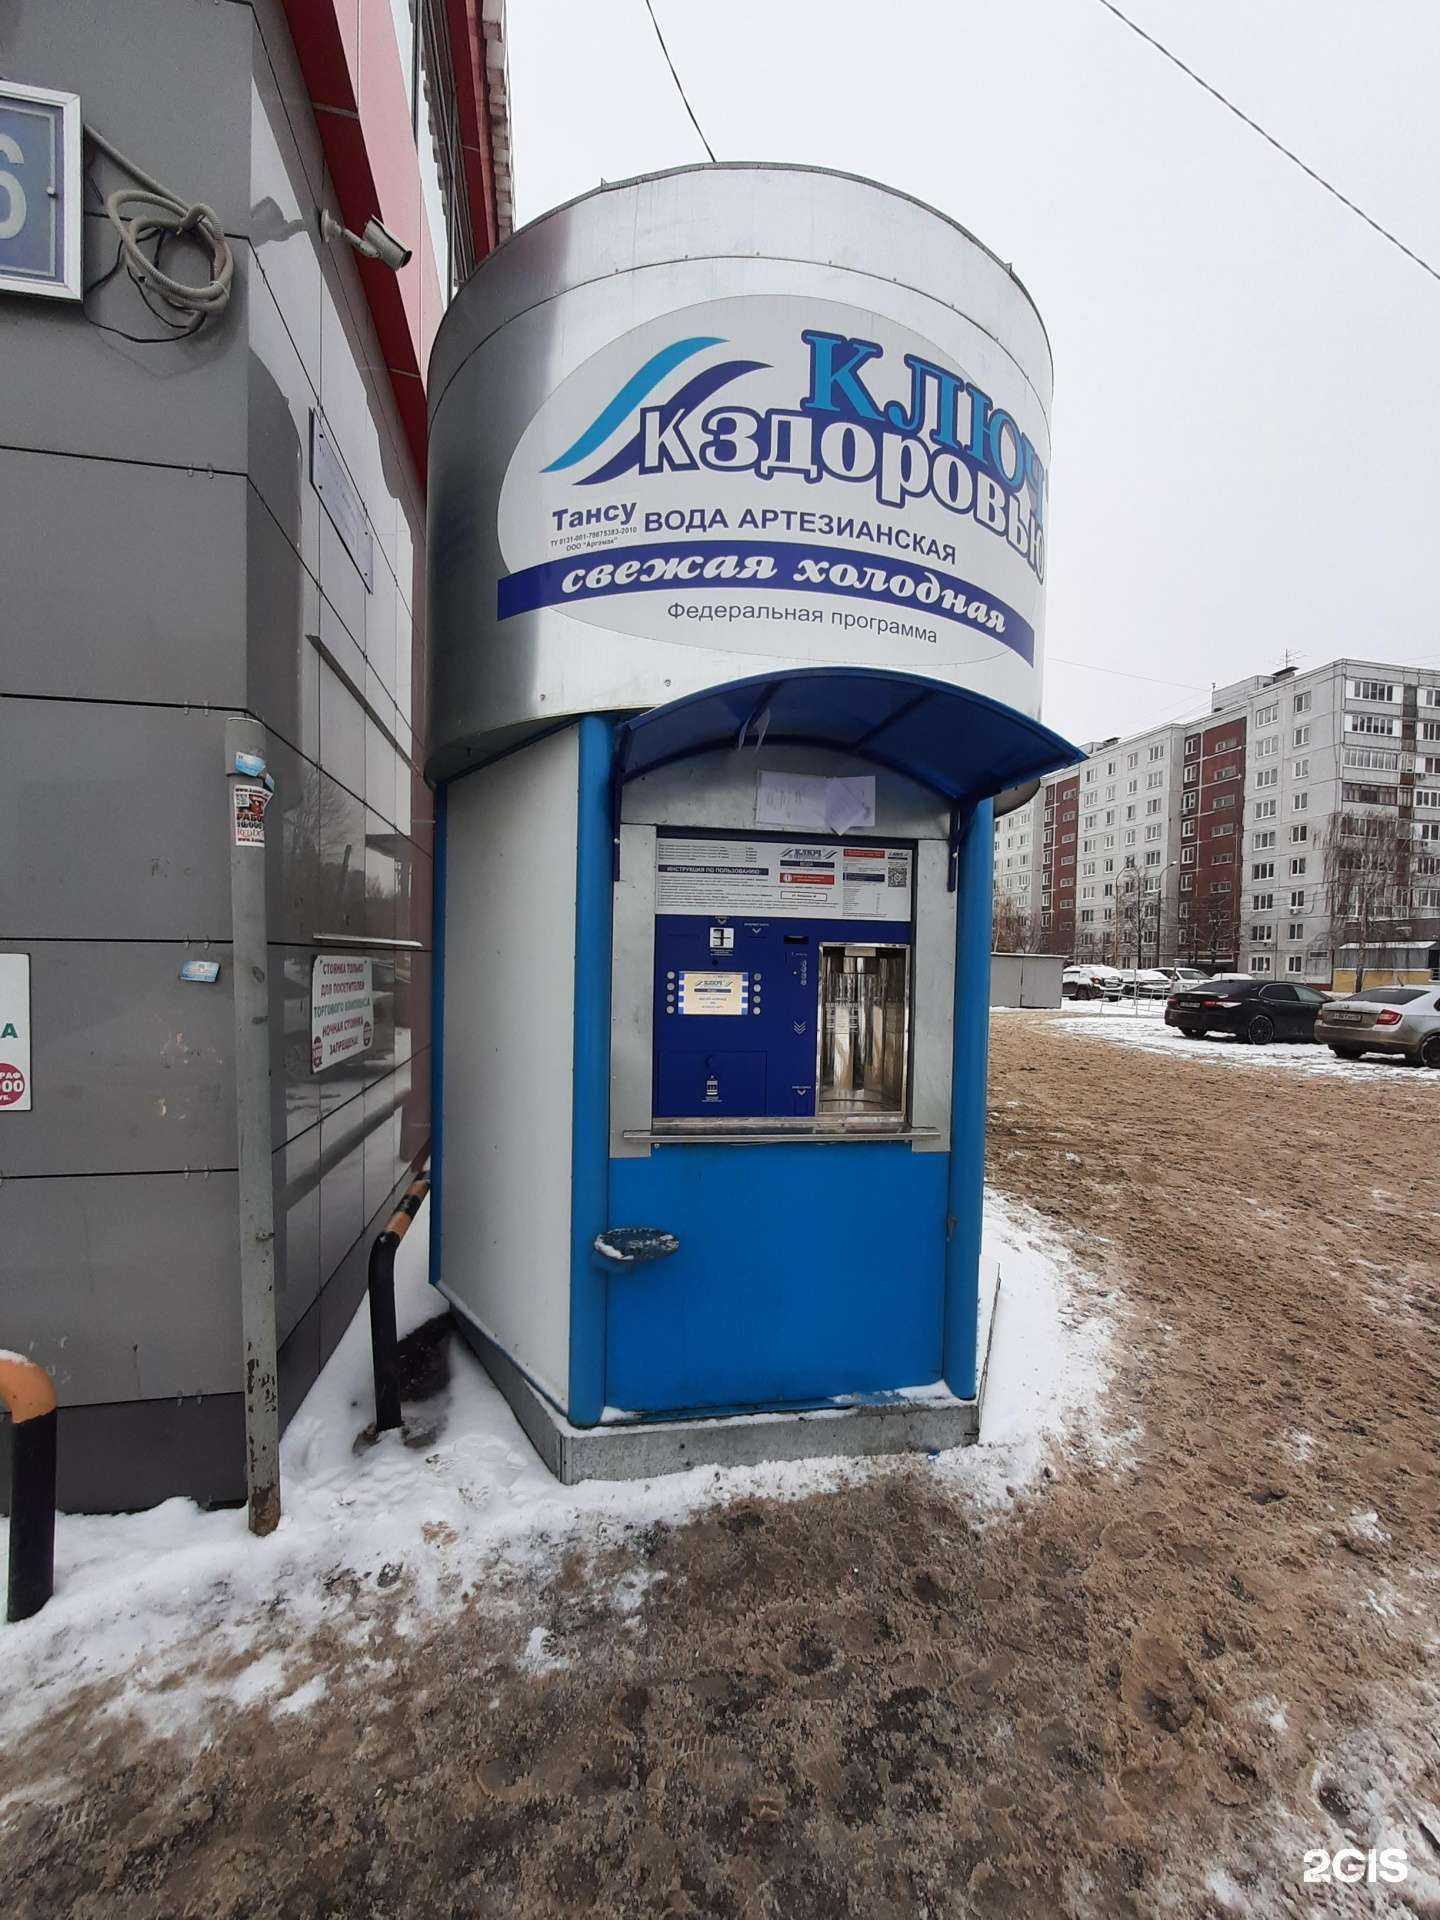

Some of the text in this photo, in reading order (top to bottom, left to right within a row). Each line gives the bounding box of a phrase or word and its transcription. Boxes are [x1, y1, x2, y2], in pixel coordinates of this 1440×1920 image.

[552, 502, 637, 532] Тансу
[644, 508, 957, 565] ВОДА АРТЕЗИАНСКАЯ
[561, 555, 1006, 634] свежая холодная
[667, 603, 937, 643] Федеральная программа
